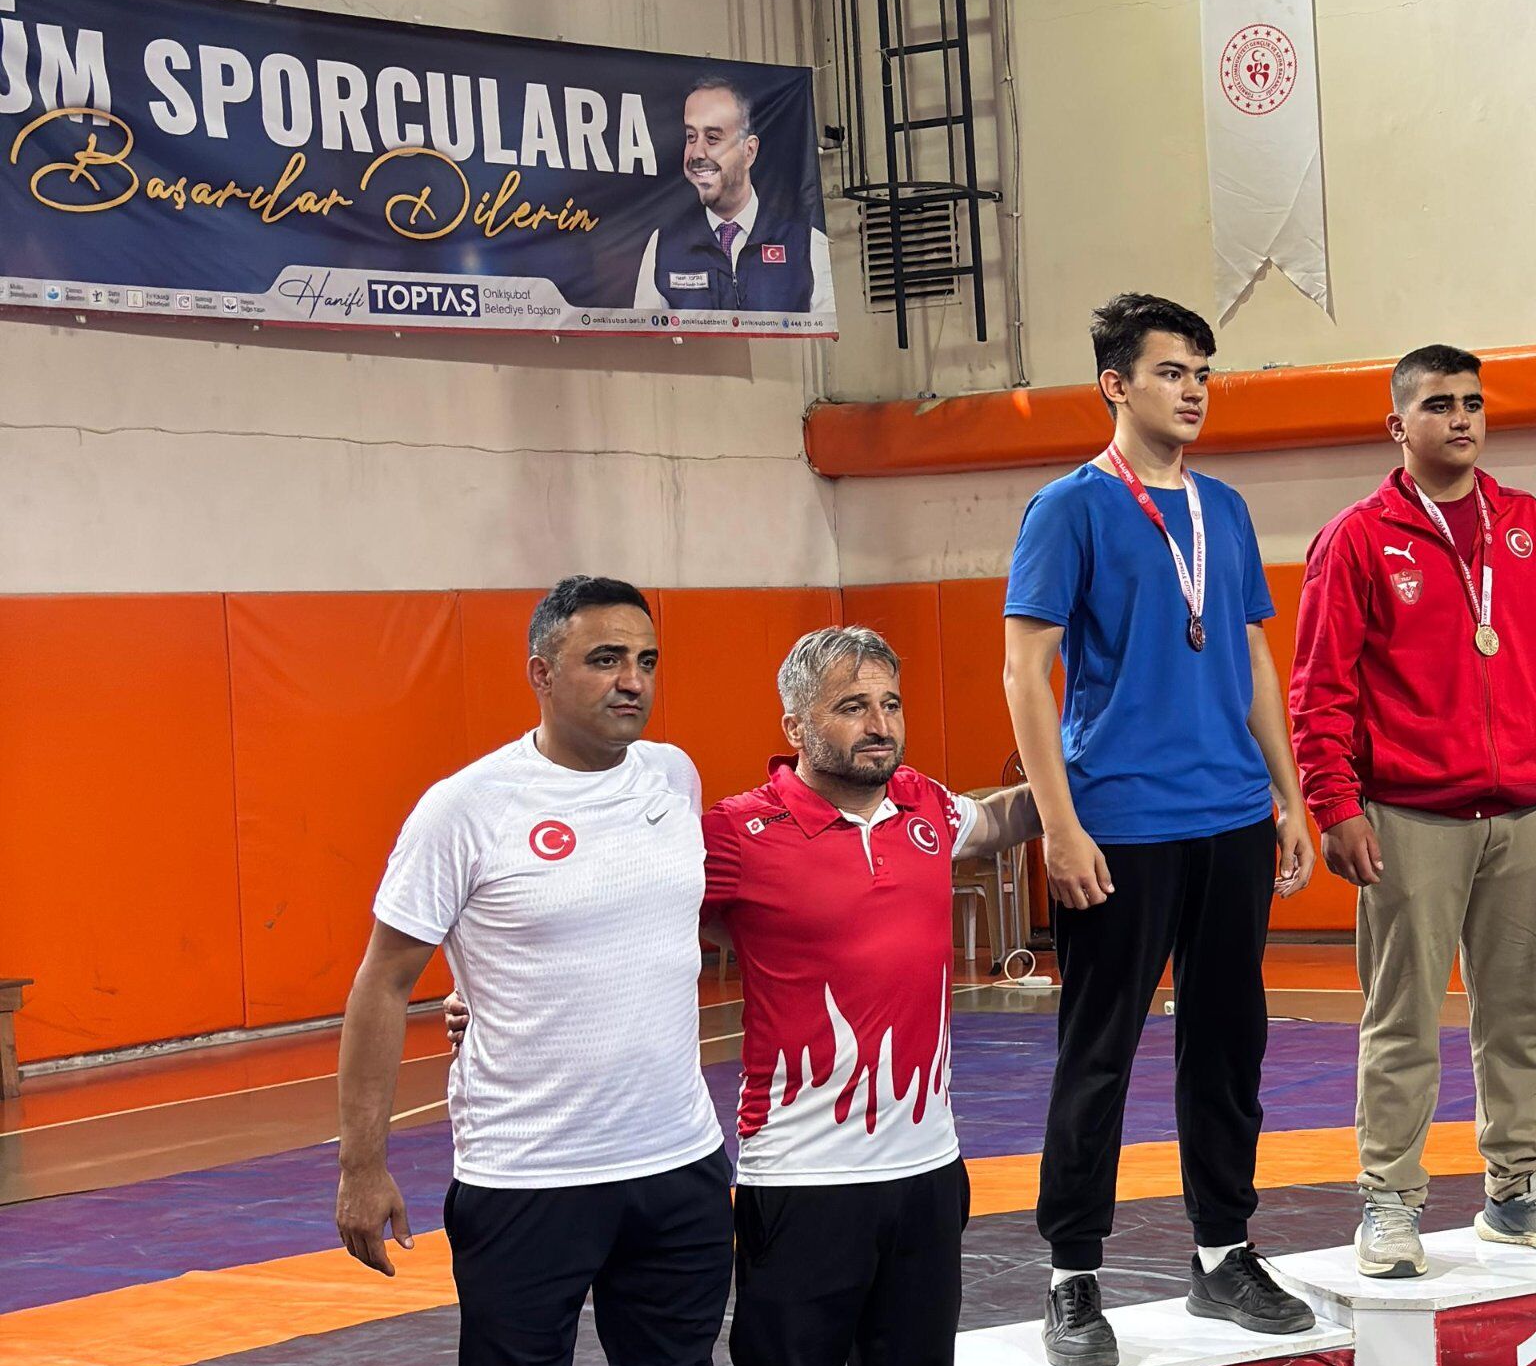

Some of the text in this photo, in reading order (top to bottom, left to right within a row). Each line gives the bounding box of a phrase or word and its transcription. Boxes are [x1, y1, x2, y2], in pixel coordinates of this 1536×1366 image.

[144, 38, 657, 176] SPORCULARA
[10, 106, 599, 240] Başarılar Dilerim
[278, 271, 478, 319] Hanifi TOPTAŞ
[483, 288, 531, 302] Onikişubat
[484, 303, 561, 317] Belediye Başkanı
